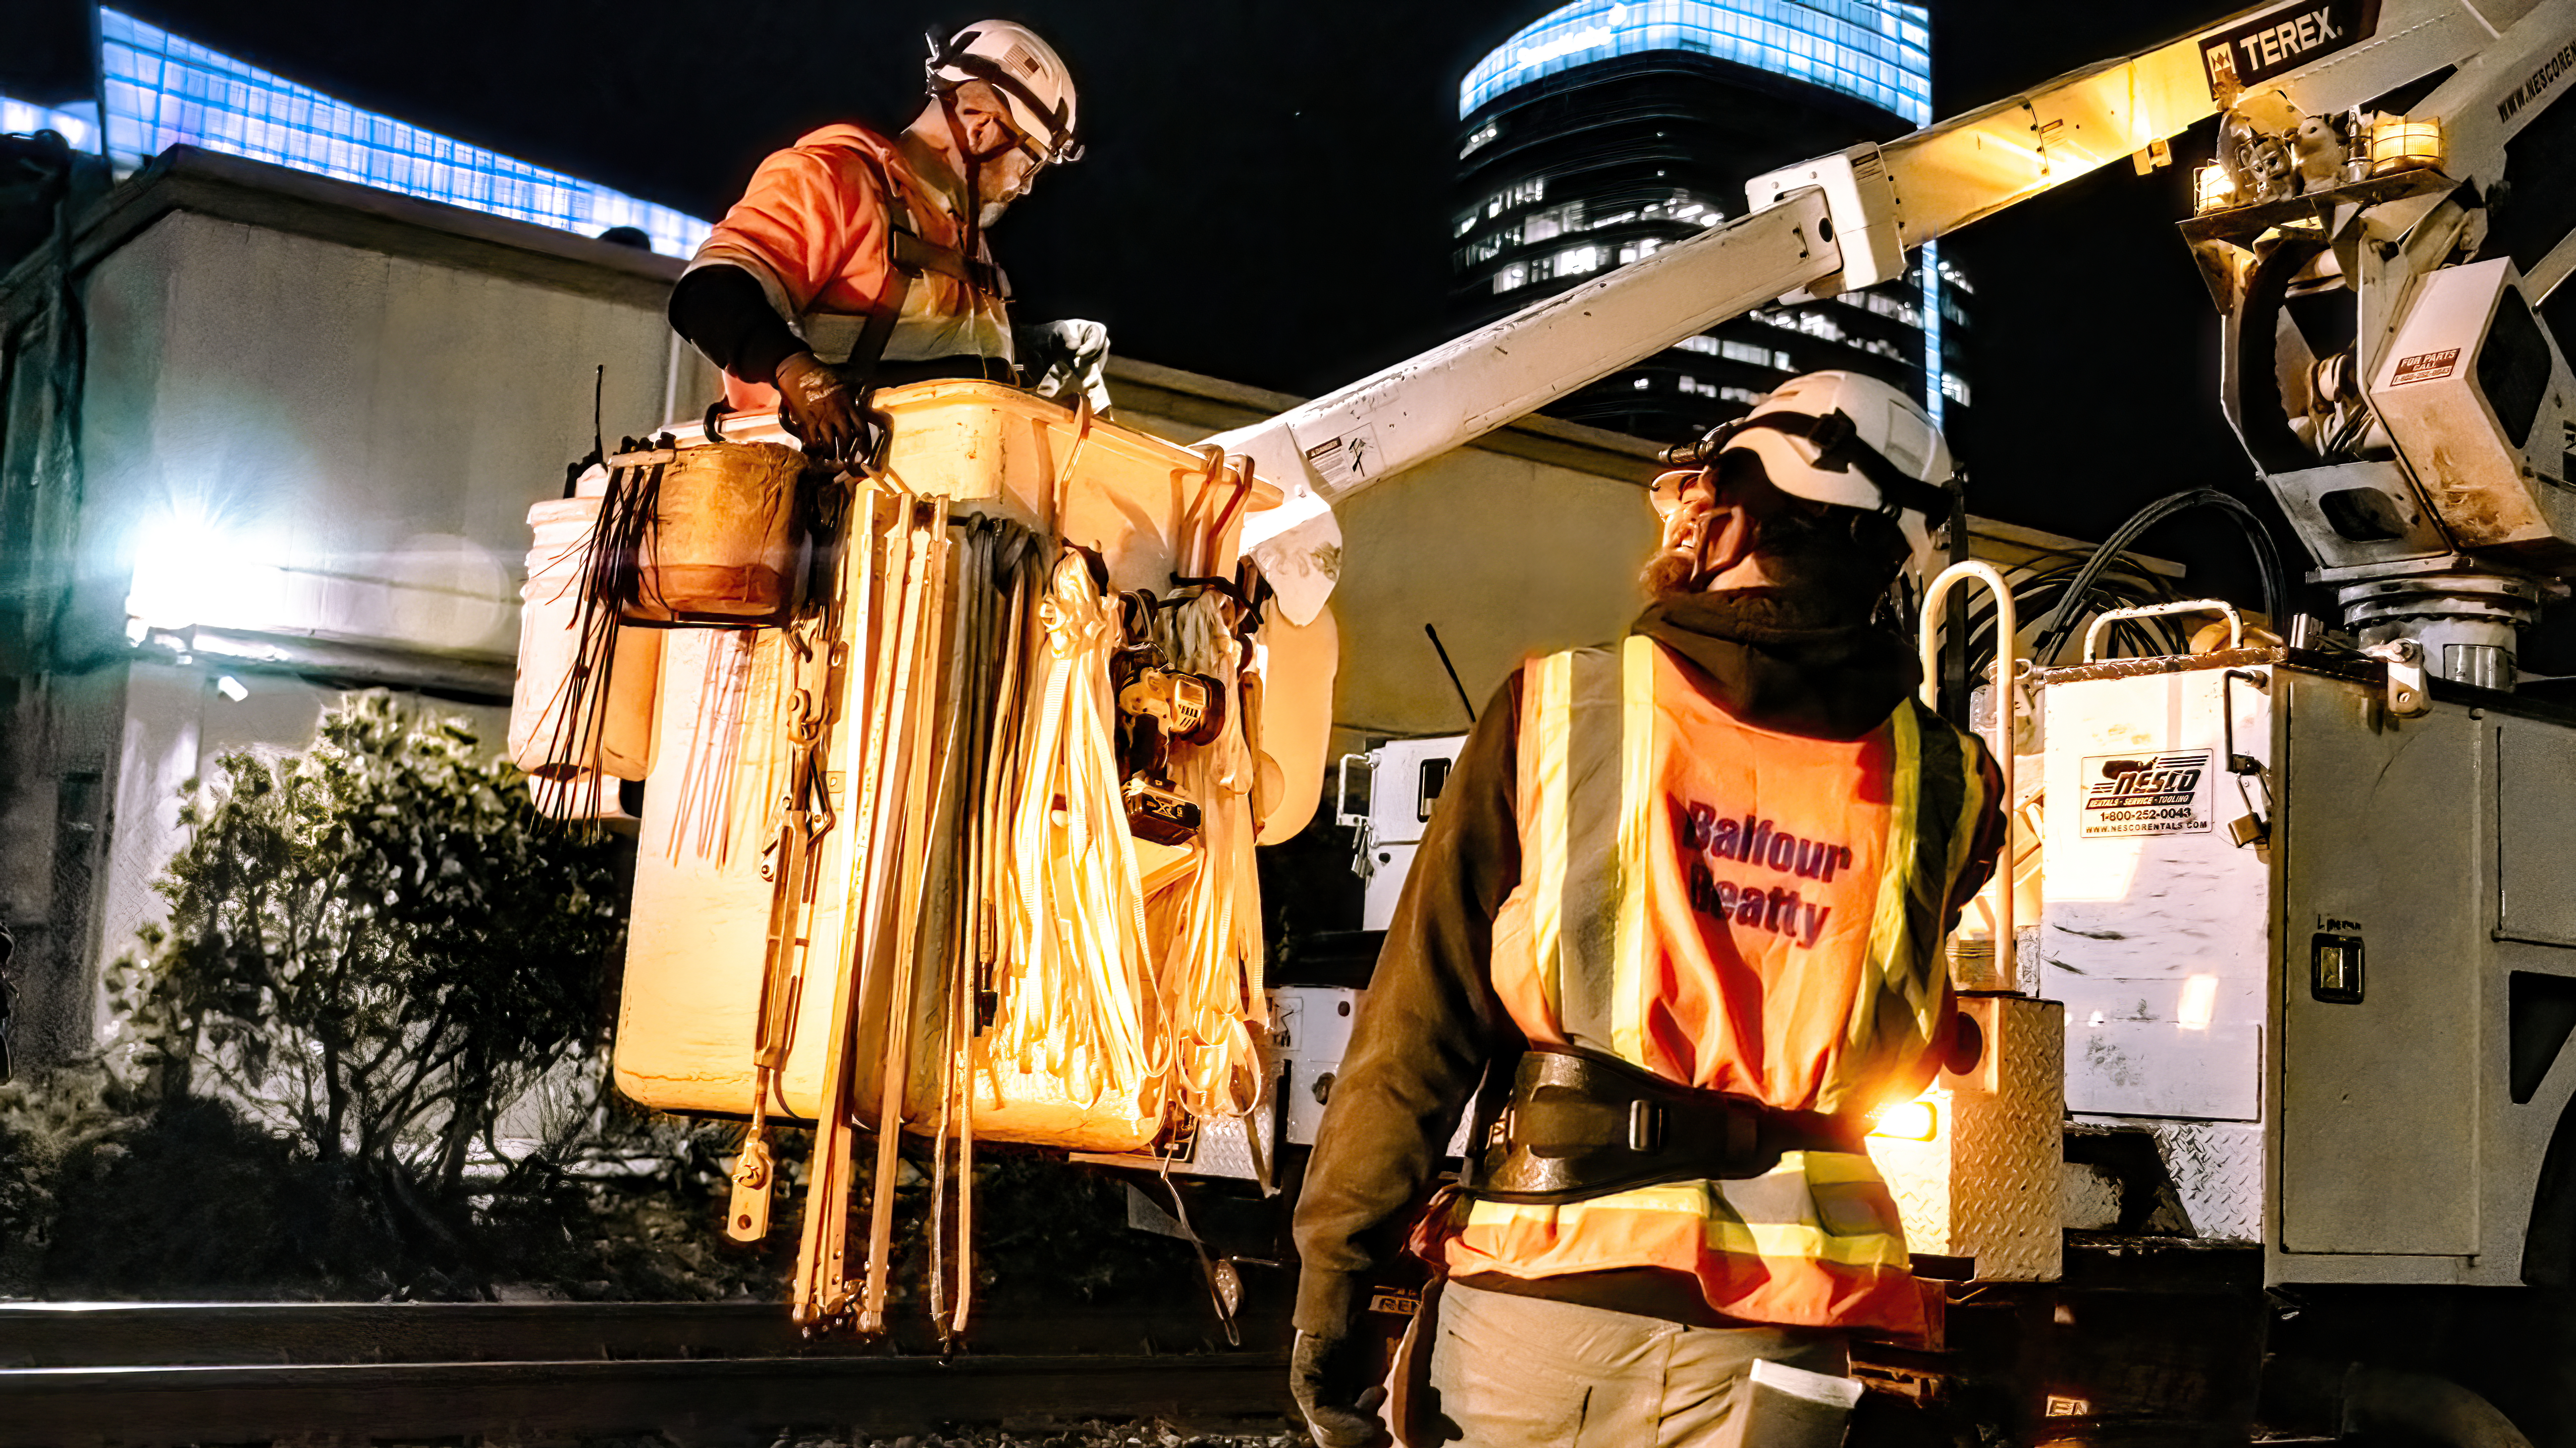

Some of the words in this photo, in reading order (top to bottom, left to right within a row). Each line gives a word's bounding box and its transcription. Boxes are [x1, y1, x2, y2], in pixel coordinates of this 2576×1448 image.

[2400, 356, 2422, 368] FOR
[2423, 350, 2456, 364] PARTS
[2100, 807, 2191, 821] 1-800-252-0043
[2085, 820, 2208, 833] WWW.NESCORENTALSCOM
[1683, 800, 1852, 883] Balfour
